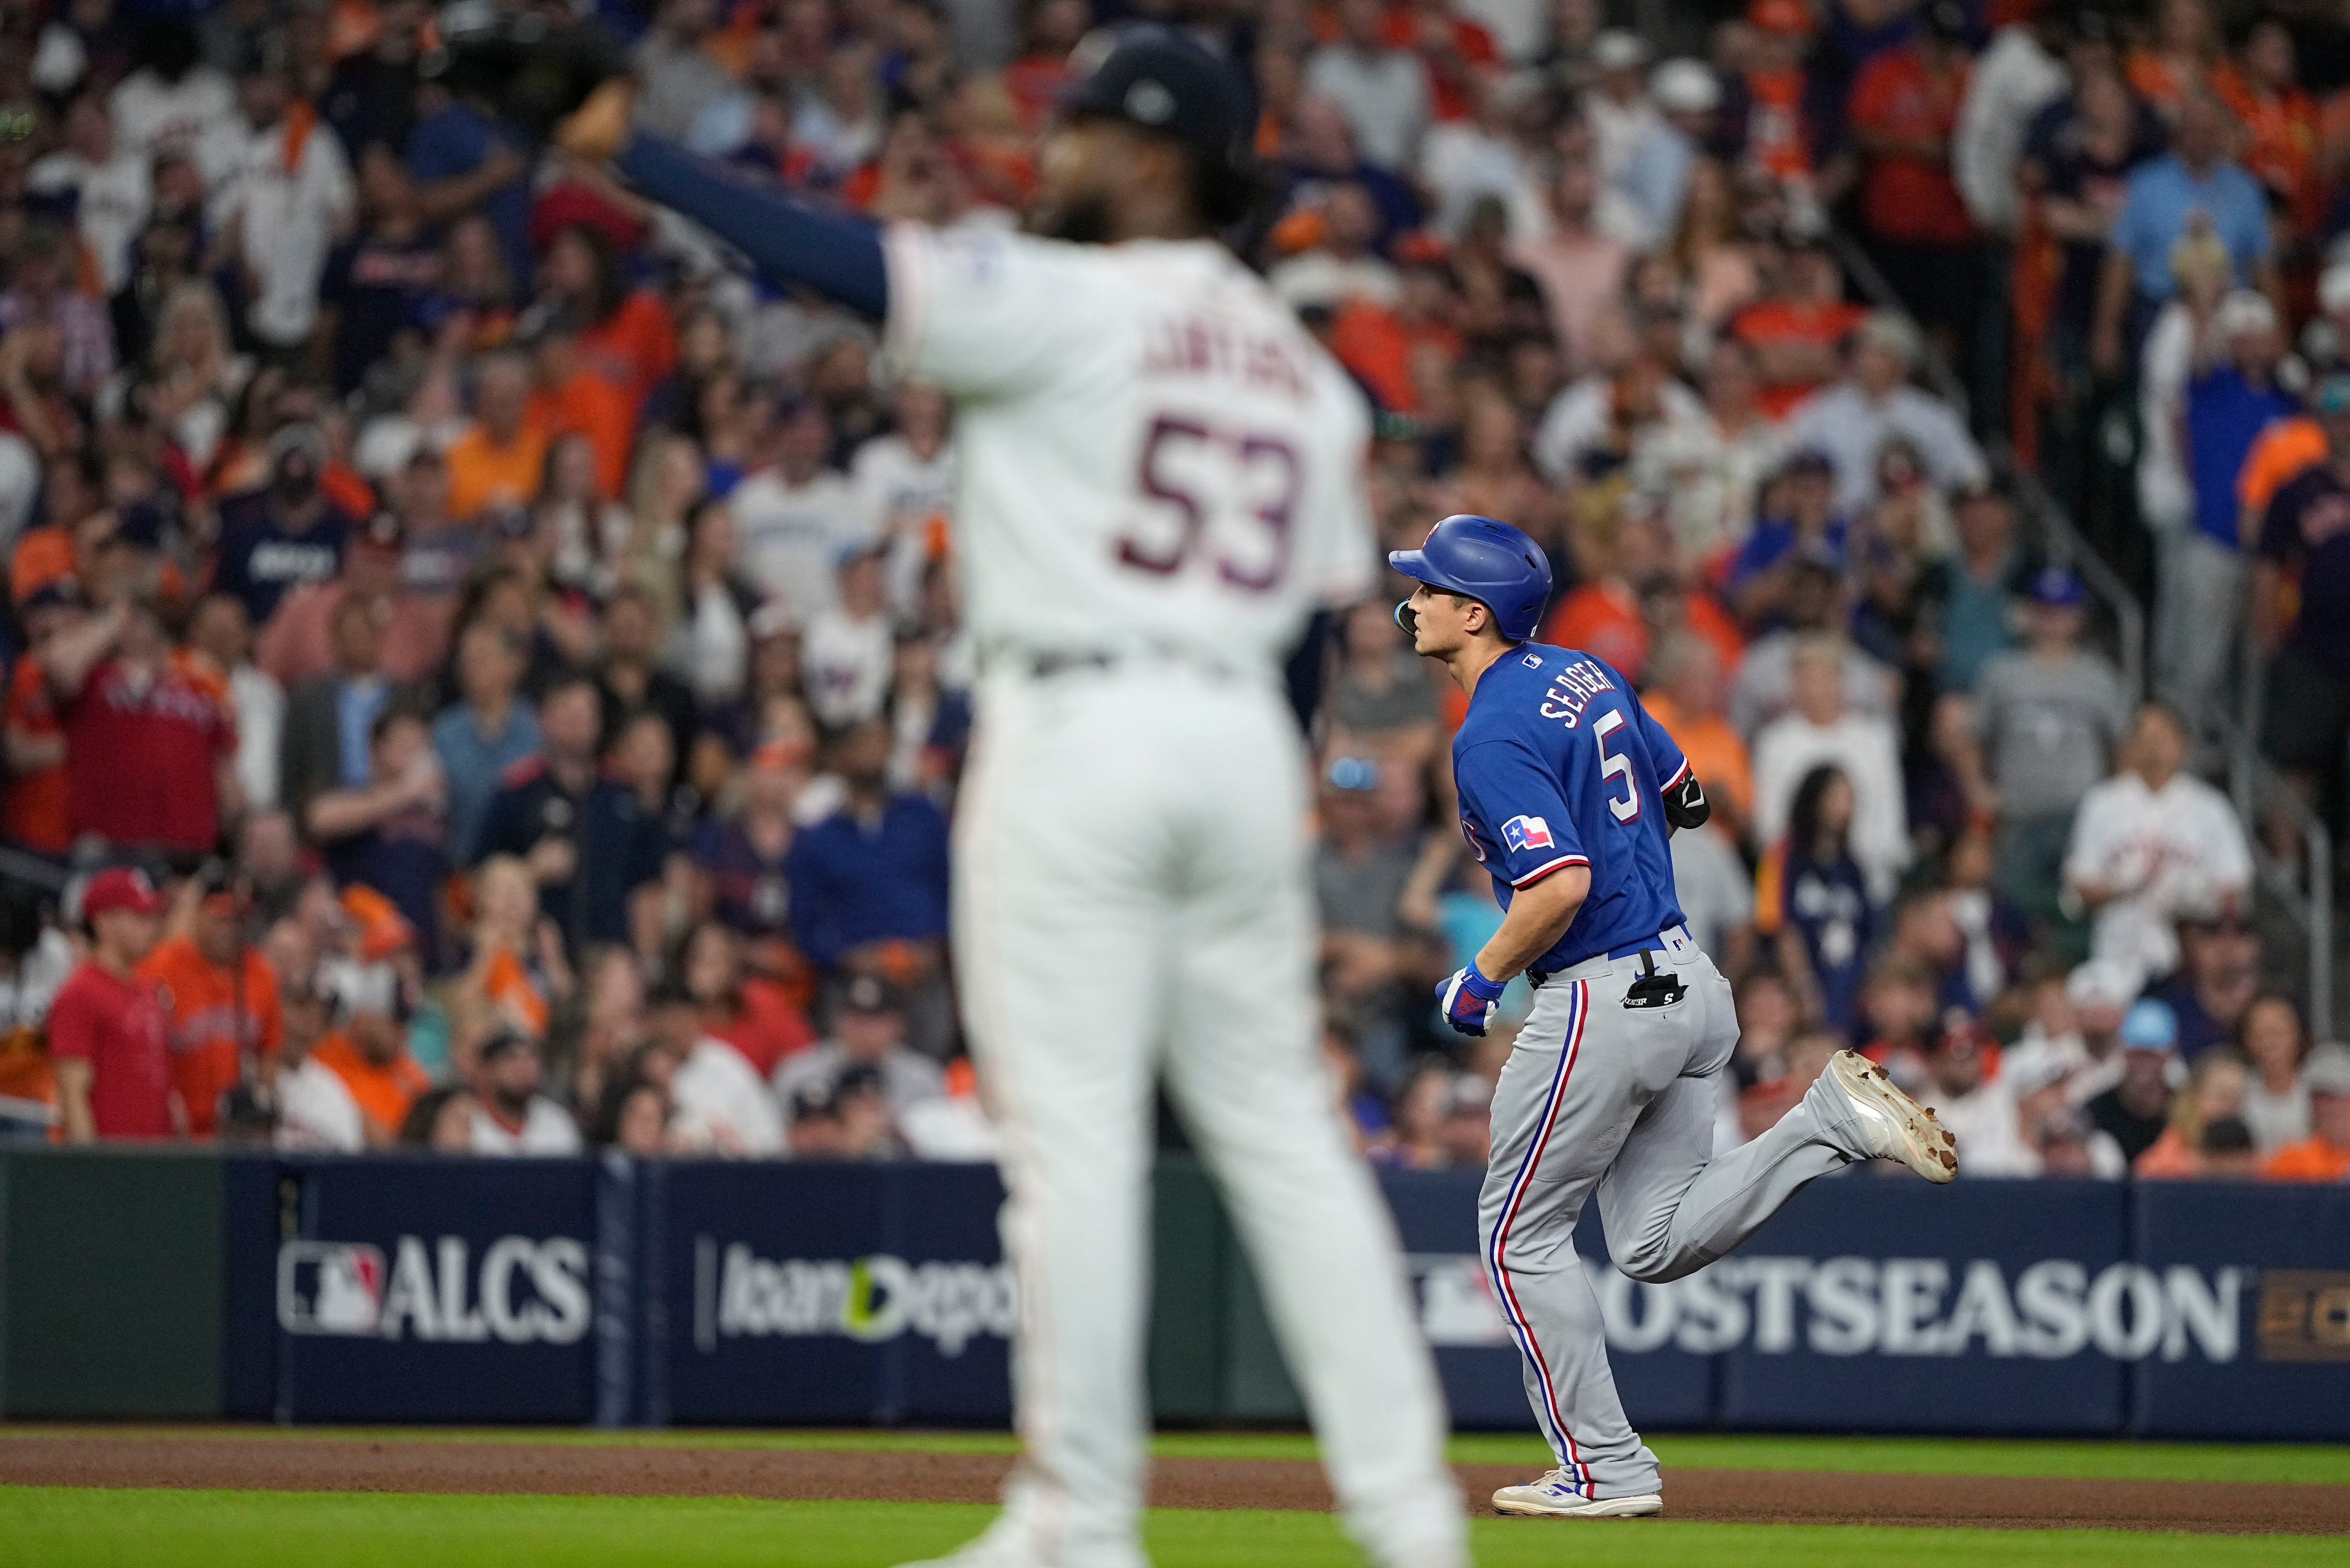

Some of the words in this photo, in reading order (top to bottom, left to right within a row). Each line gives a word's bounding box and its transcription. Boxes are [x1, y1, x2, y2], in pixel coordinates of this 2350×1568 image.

[1117, 413, 1303, 593] 53
[1540, 660, 1617, 729] SEAGER
[1593, 708, 1641, 826] 5
[380, 1234, 593, 1346] ALCS
[719, 1240, 1021, 1359] loanDepo
